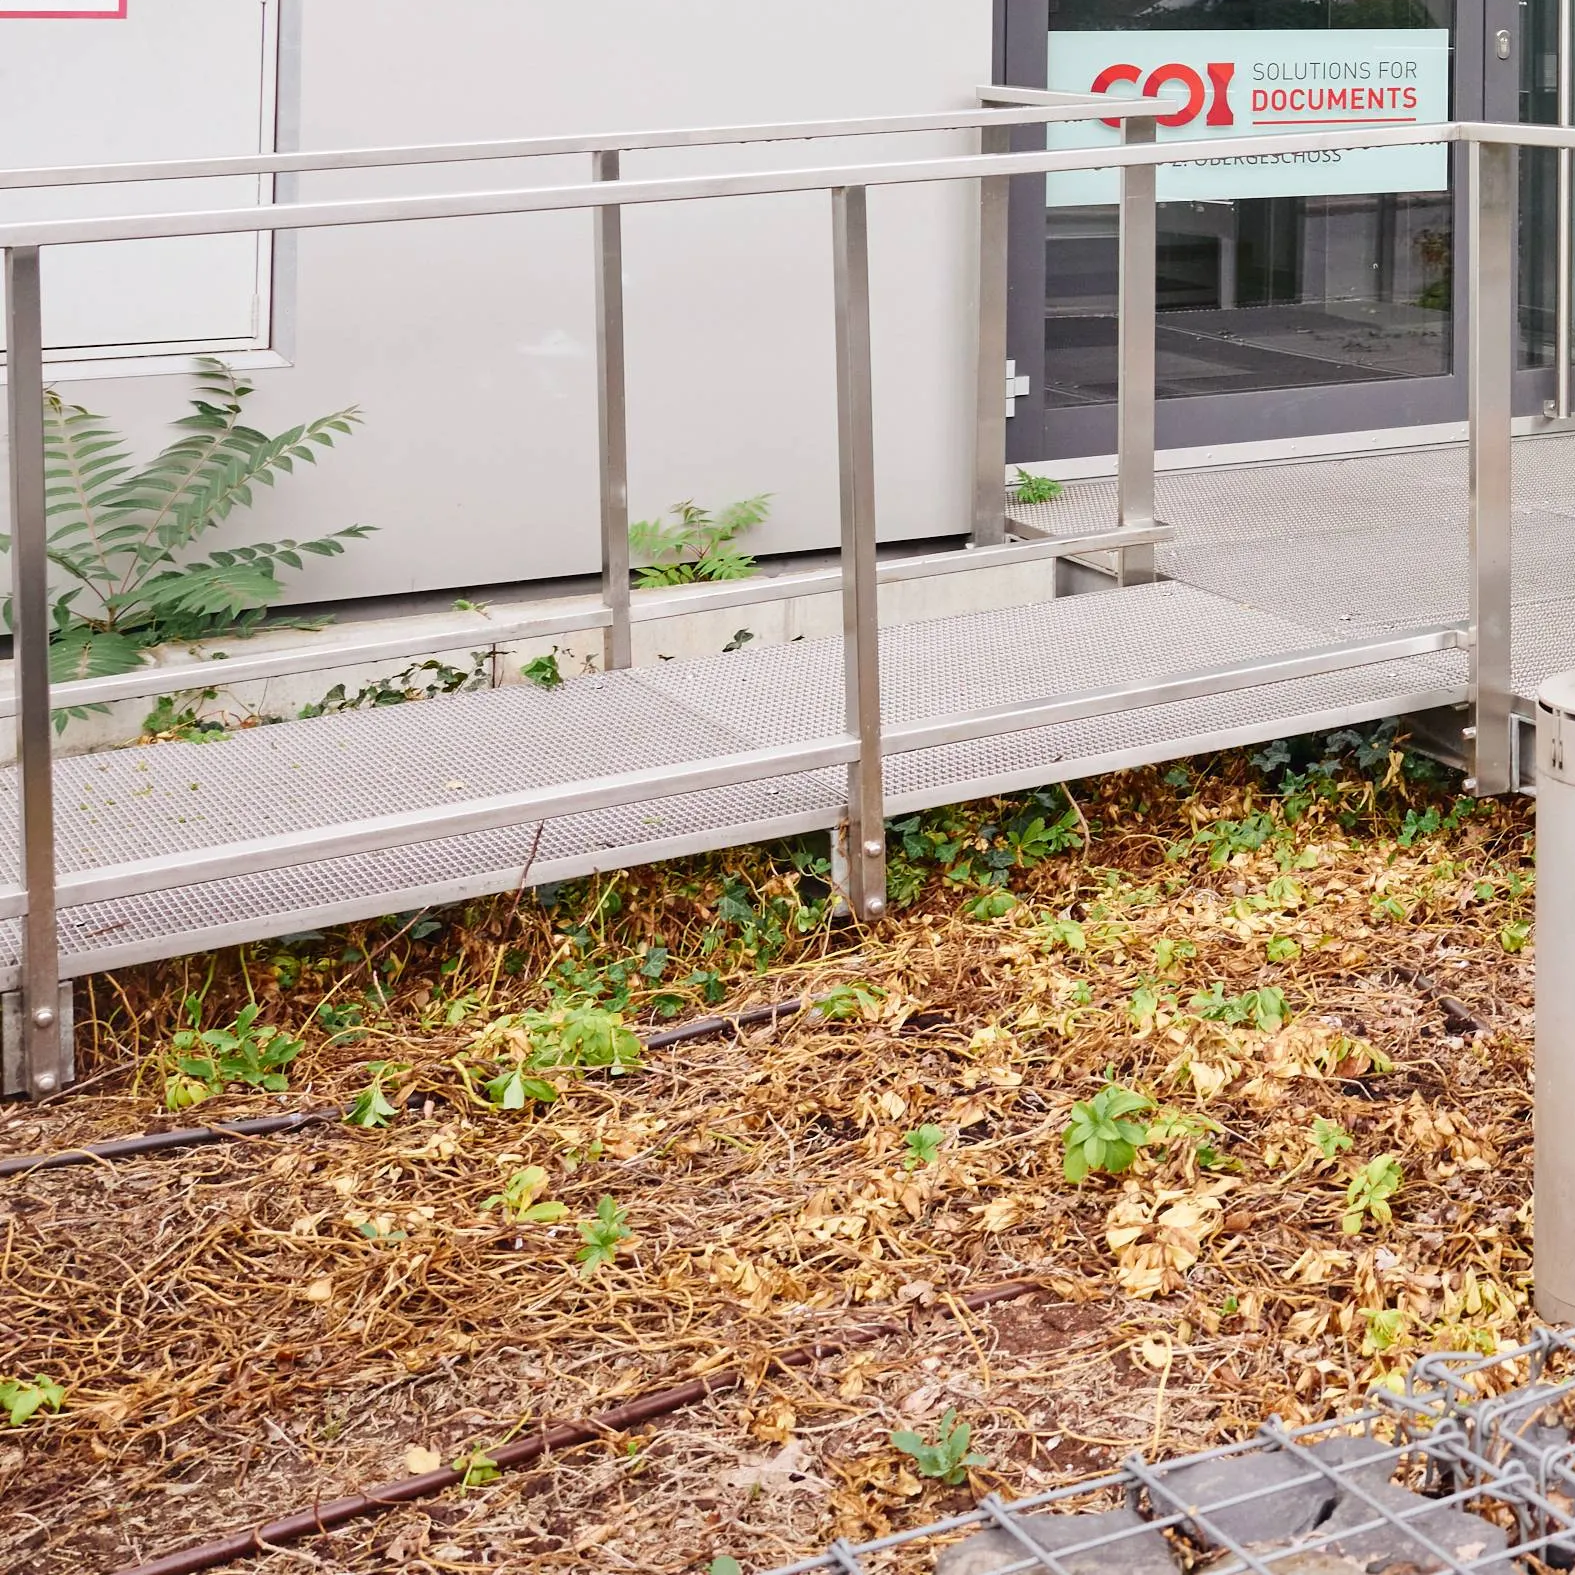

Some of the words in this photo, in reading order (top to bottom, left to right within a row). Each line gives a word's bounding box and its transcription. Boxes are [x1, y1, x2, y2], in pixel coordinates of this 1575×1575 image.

[1252, 61, 1371, 81] SOLUTIONS
[1378, 61, 1417, 79] FOR
[1252, 86, 1418, 112] DOCUMENTS
